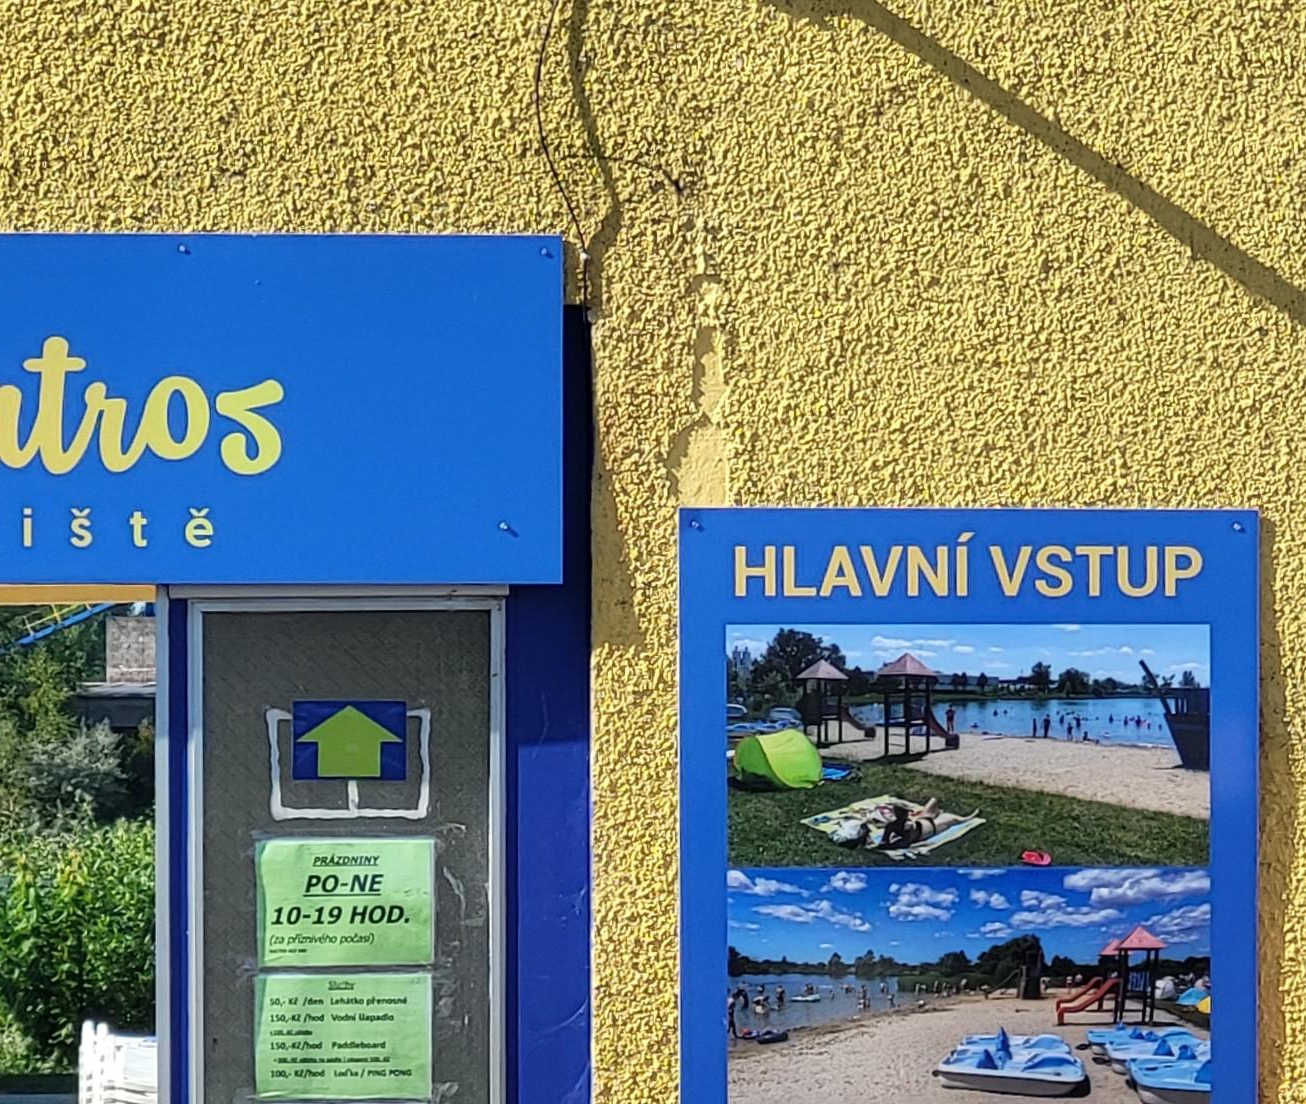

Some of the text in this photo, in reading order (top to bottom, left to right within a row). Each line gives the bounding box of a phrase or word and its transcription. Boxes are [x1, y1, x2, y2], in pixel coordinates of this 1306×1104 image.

[733, 532, 1204, 598] HLAVNÍ VSTUP
[313, 853, 380, 867] PRÁZDNINY
[304, 874, 384, 896] PO-NE
[271, 905, 410, 925] 10-19 HOD.
